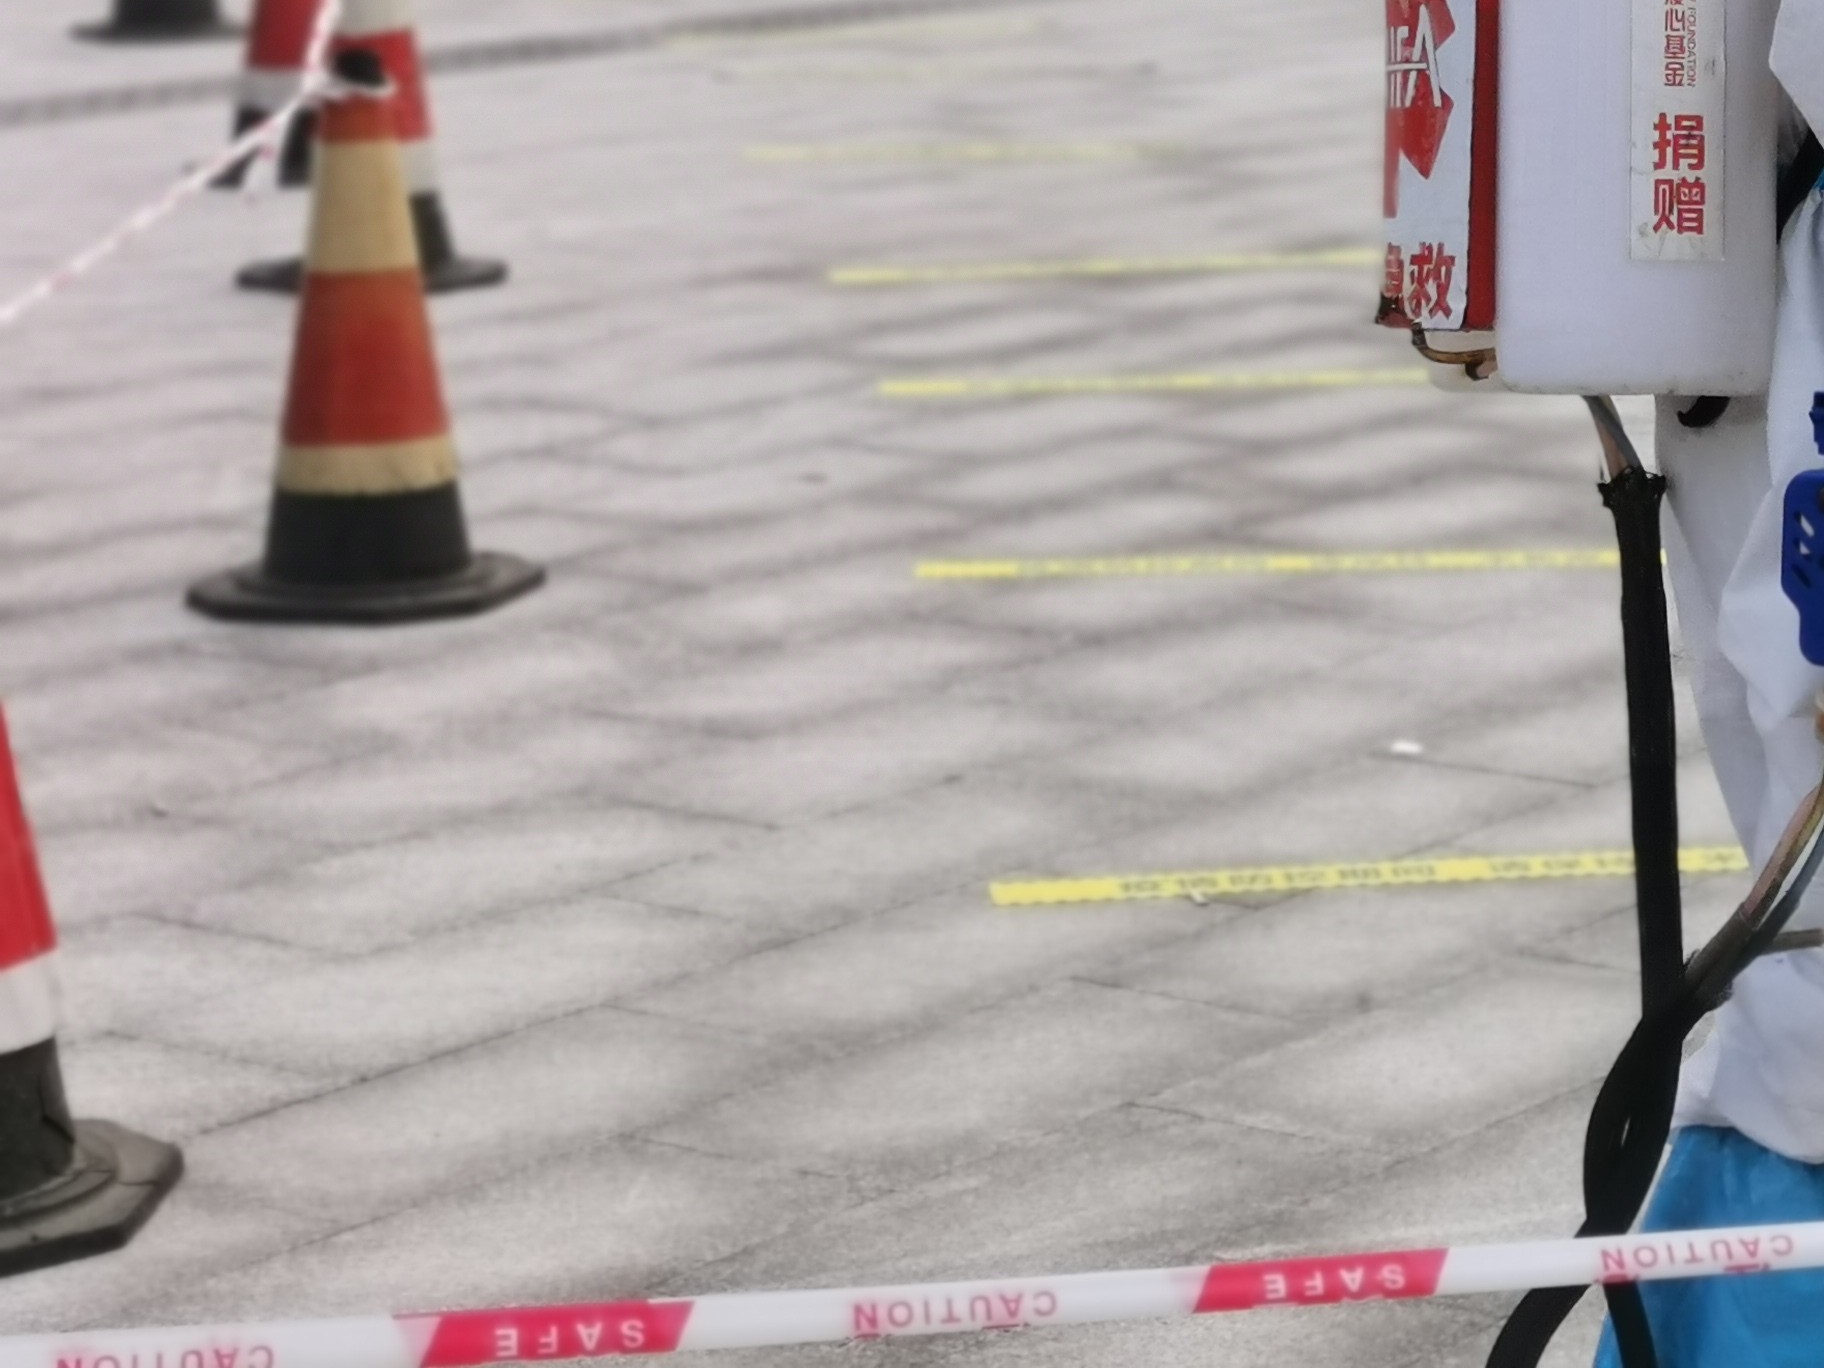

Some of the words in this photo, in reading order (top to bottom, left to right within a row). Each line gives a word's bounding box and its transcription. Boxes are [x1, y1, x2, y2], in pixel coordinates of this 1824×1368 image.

[1651, 111, 1707, 236] 捐赠
[1600, 1234, 1795, 1273] CAUTION
[1262, 1263, 1406, 1300] SAFE
[853, 1290, 1058, 1333] CAUTION
[493, 1318, 646, 1358] SAFE
